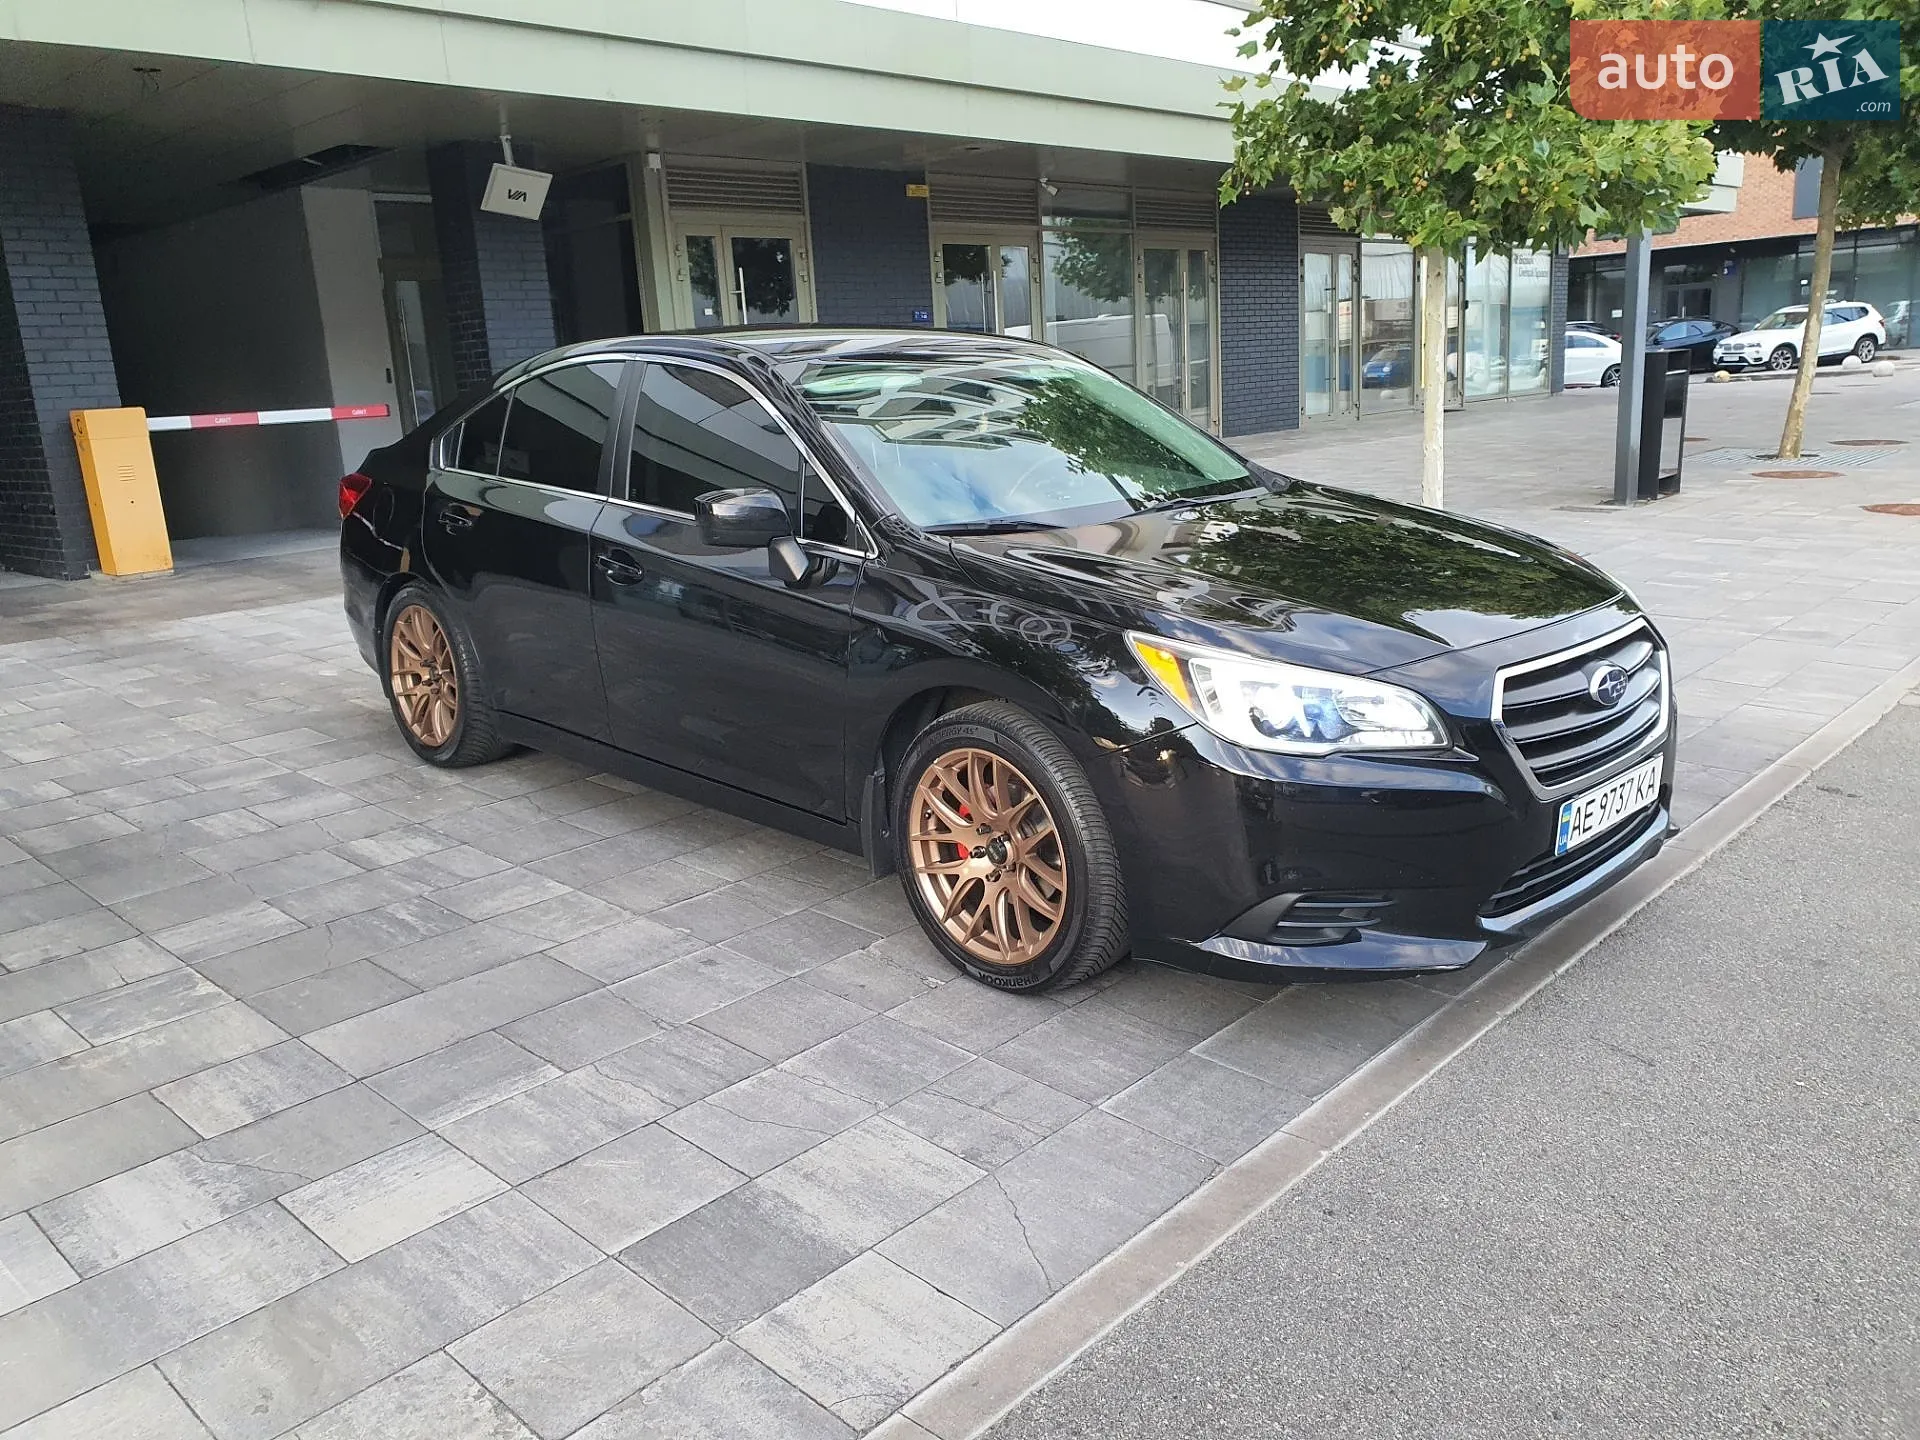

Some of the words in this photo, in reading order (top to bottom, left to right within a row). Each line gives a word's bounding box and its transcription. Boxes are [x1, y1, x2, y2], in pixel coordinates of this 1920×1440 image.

[1570, 798, 1596, 841] AE
[1598, 777, 1634, 825] 9737
[1635, 766, 1656, 804] KA
